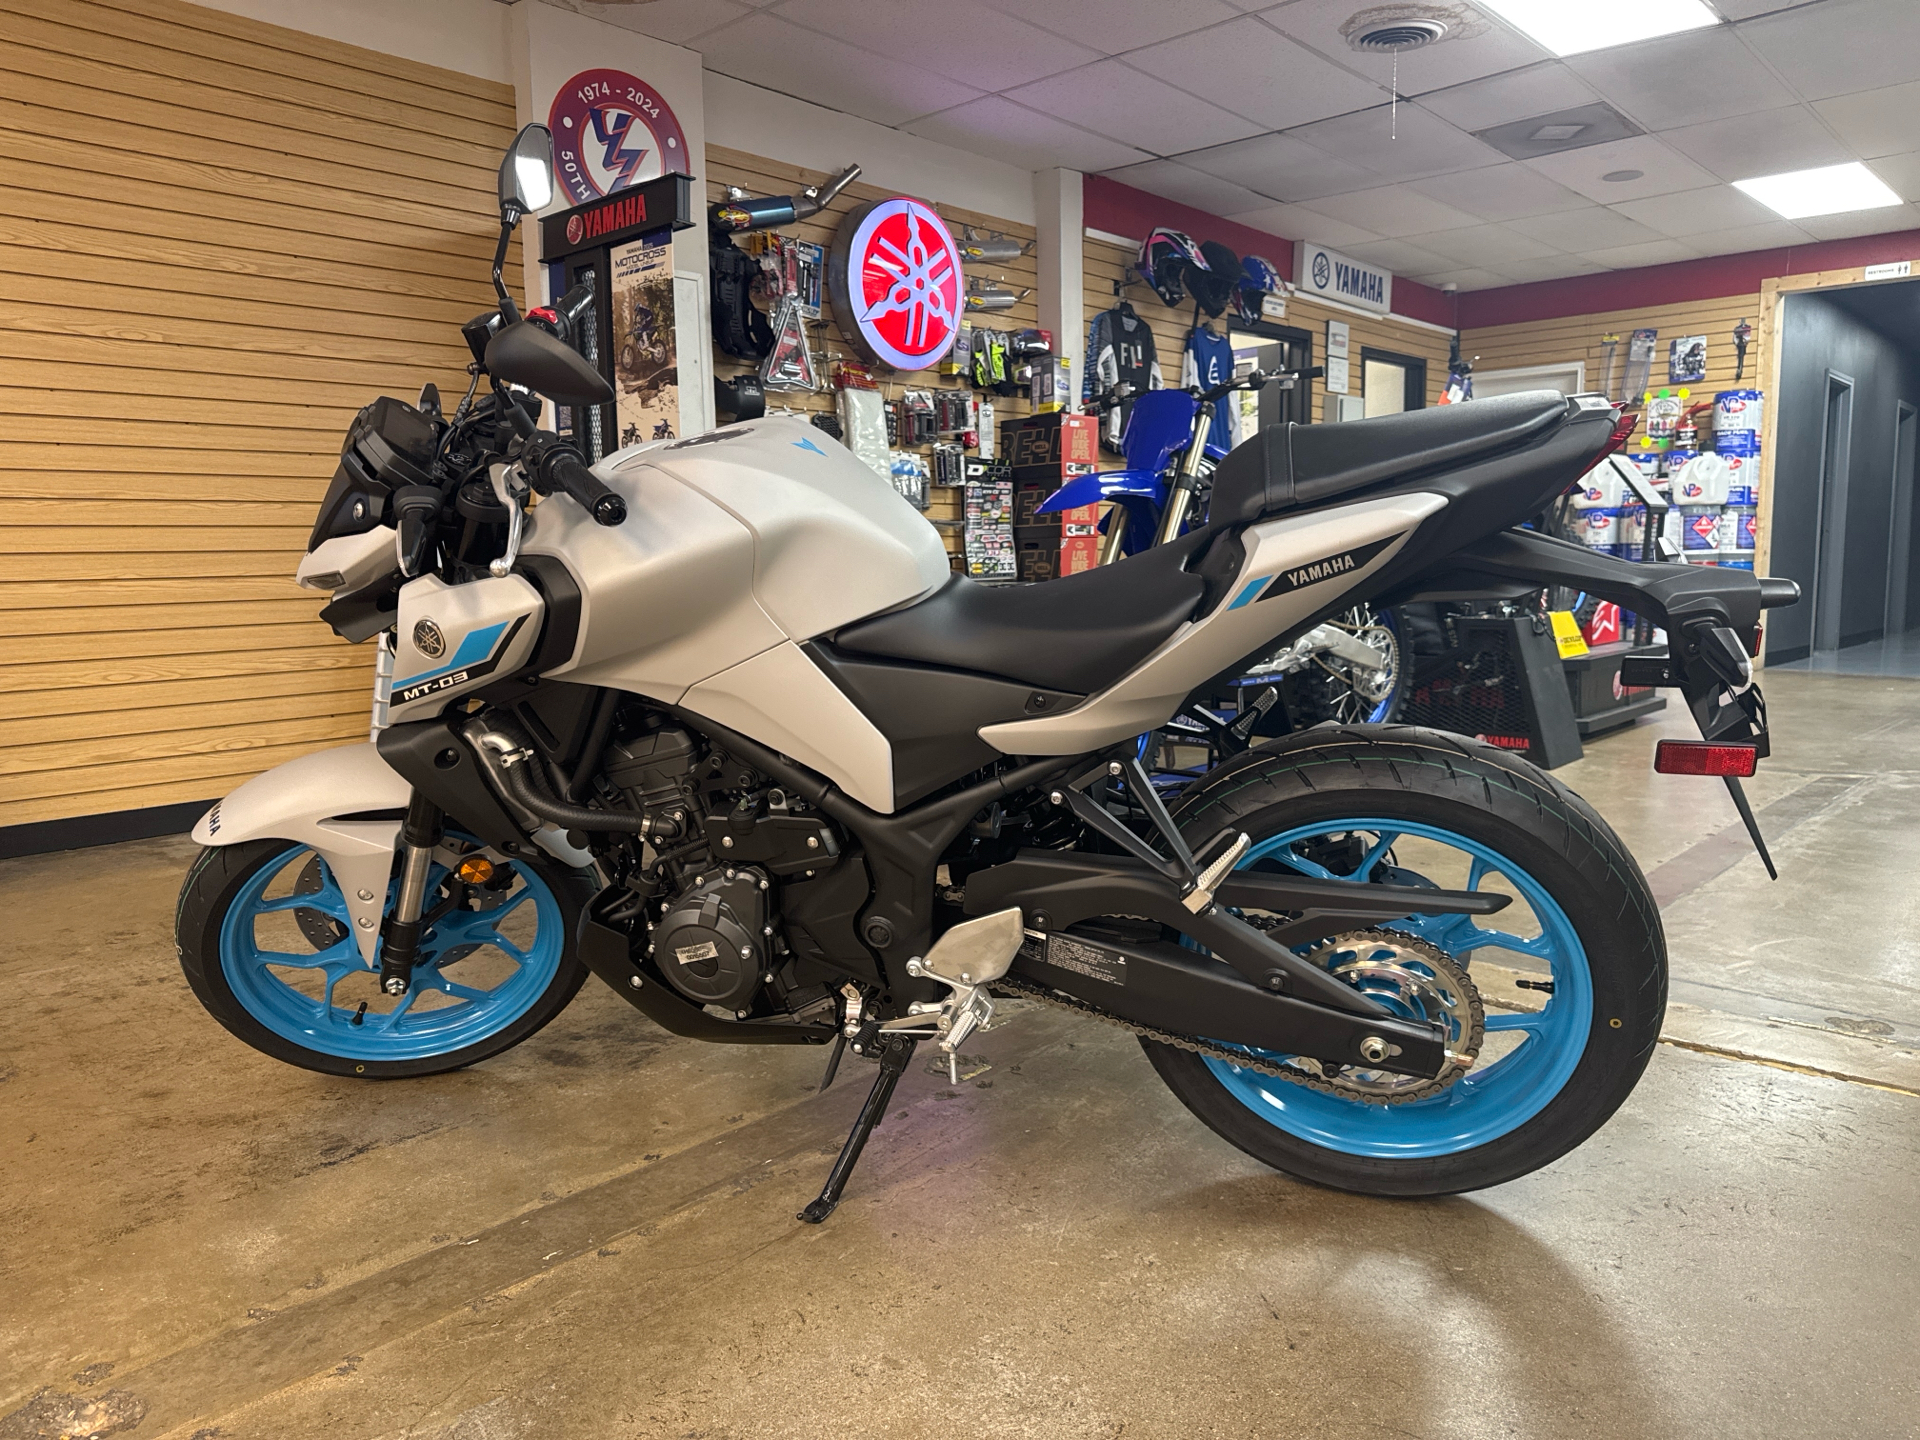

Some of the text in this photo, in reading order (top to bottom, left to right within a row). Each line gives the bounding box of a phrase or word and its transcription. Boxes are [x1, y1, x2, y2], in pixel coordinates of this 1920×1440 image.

[578, 82, 610, 103] 1974
[627, 87, 660, 118] 2024
[561, 150, 591, 200] 50TH
[584, 194, 647, 239] YAMAHA
[615, 247, 667, 269] MOTOCROSS
[1335, 262, 1384, 304] YAMAHA
[1683, 483, 1697, 498] VP
[1287, 555, 1355, 587] YAMAHA
[403, 670, 469, 701] MT-03
[1487, 735, 1530, 749] YAMAHA
